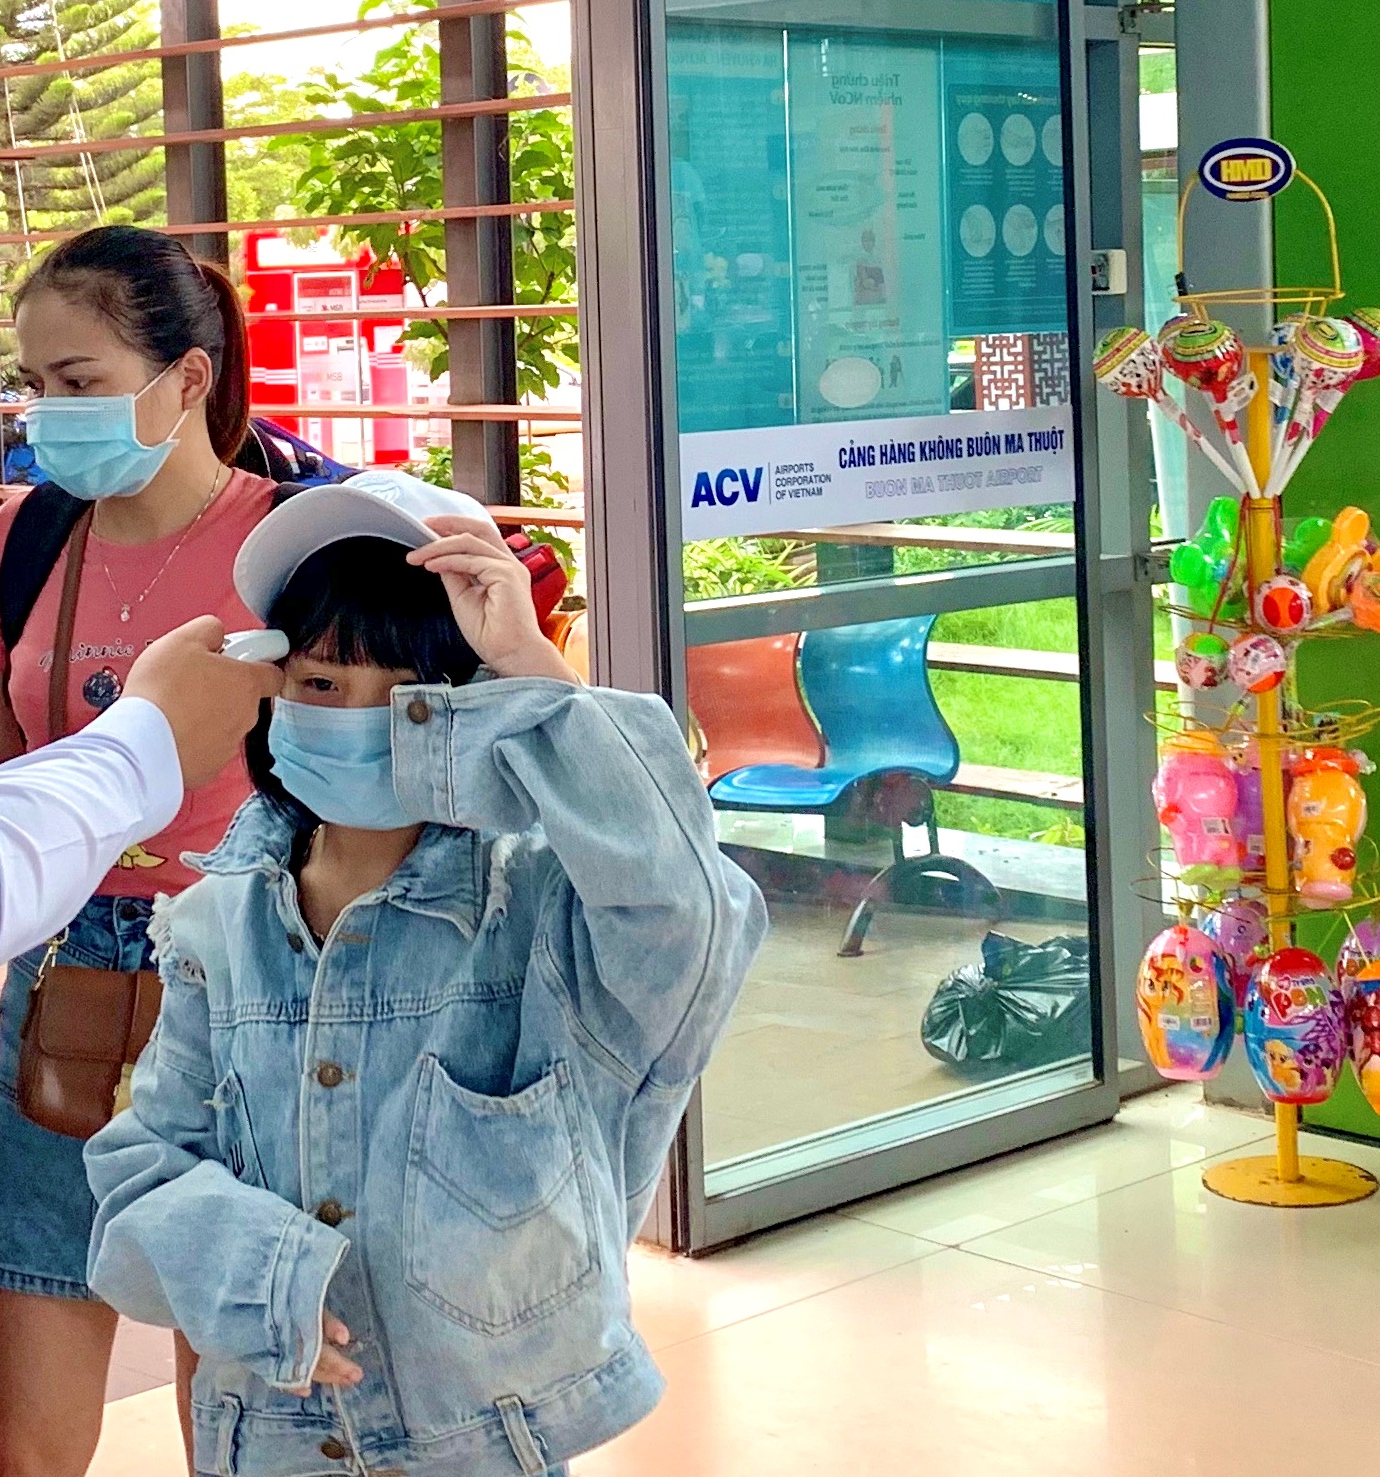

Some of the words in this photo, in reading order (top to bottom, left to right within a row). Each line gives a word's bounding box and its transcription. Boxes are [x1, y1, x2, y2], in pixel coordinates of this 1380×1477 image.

[1220, 158, 1272, 182] HMD
[838, 439, 876, 469] CẢNG
[879, 438, 916, 465] HÀNG
[919, 435, 963, 462] KHÔNG
[966, 431, 1001, 458] BUÔN
[1004, 434, 1024, 454] MA
[1027, 426, 1065, 455] THUỘT
[775, 463, 815, 475] AIRPORTS
[775, 474, 832, 488] CORPORATION
[690, 467, 764, 508] ACV
[775, 490, 787, 500] OF
[788, 486, 823, 499] VIETNAM
[865, 478, 908, 499] BUON
[911, 476, 935, 495] MA
[937, 470, 983, 493] THUOT
[985, 465, 1044, 488] AIRPORT
